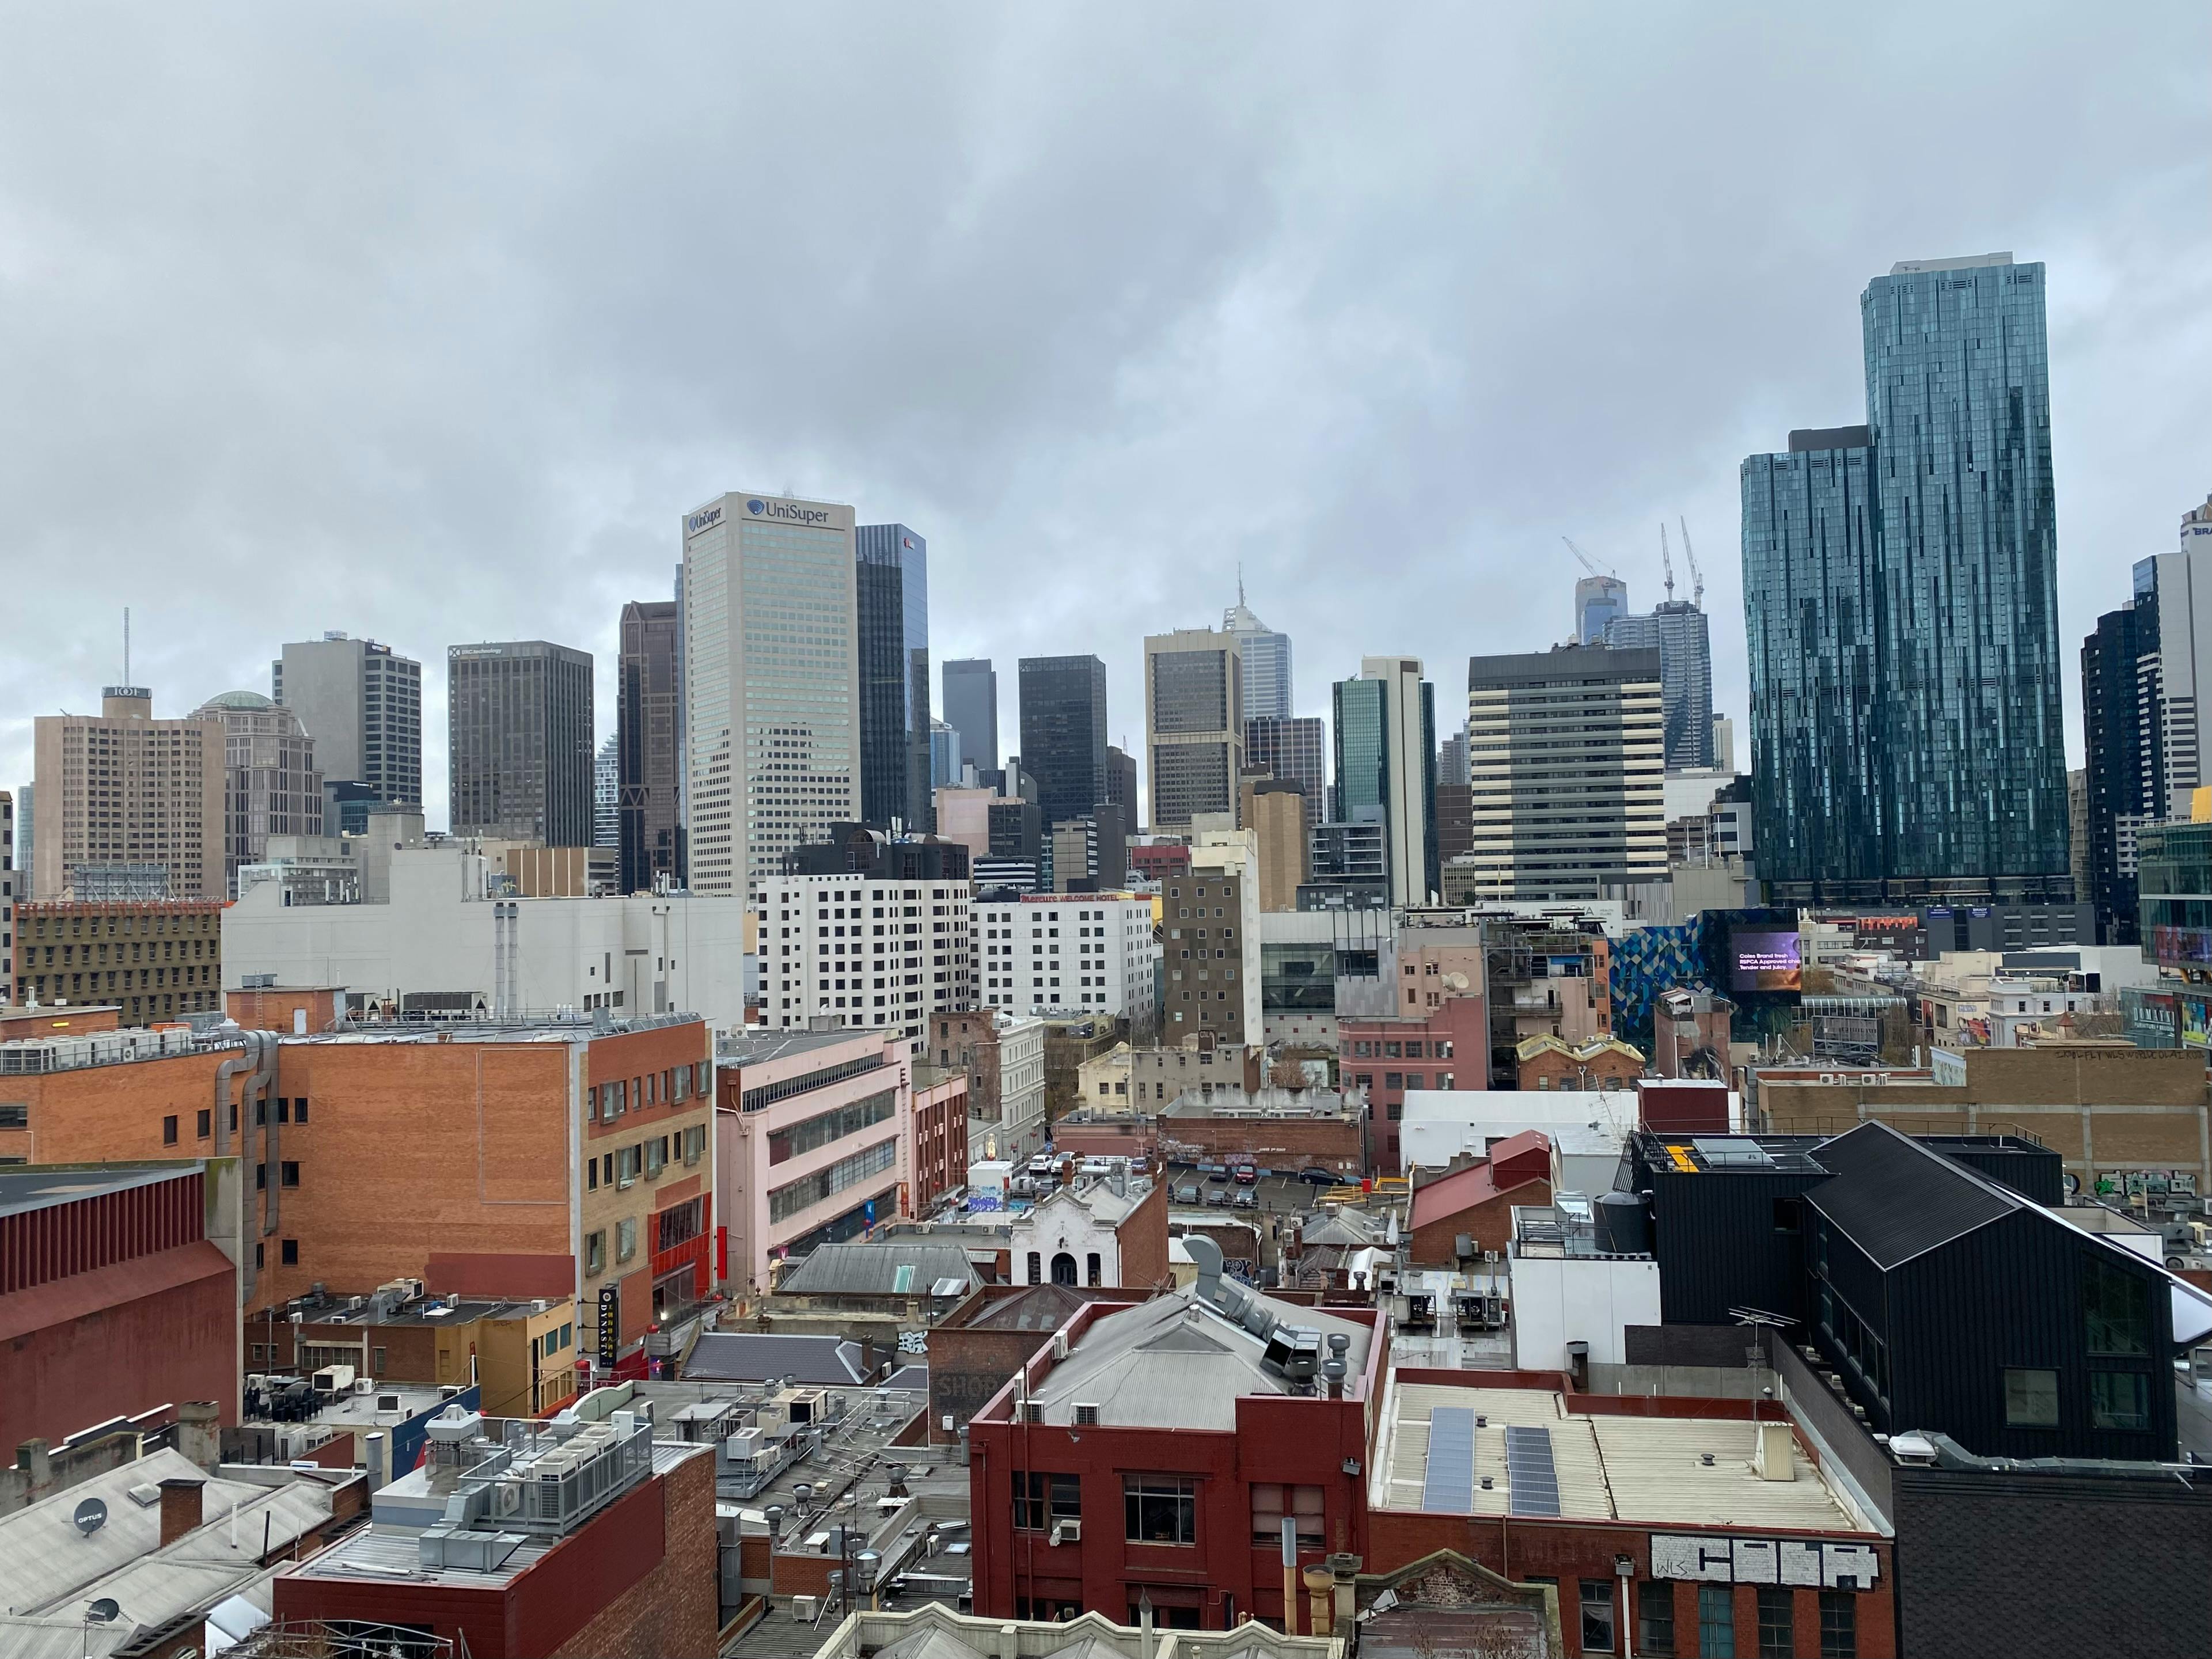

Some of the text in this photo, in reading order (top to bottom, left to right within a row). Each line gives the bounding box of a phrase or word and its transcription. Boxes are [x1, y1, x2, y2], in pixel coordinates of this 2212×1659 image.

[696, 507, 722, 529] UniSuper
[766, 502, 829, 525] UniSuper
[115, 687, 140, 696] IOOF
[1021, 895, 1058, 903] Mercure
[1096, 894, 1120, 902] HOTEL
[78, 1513, 102, 1523] OPTUS
[1656, 1559, 1689, 1576] WLS
